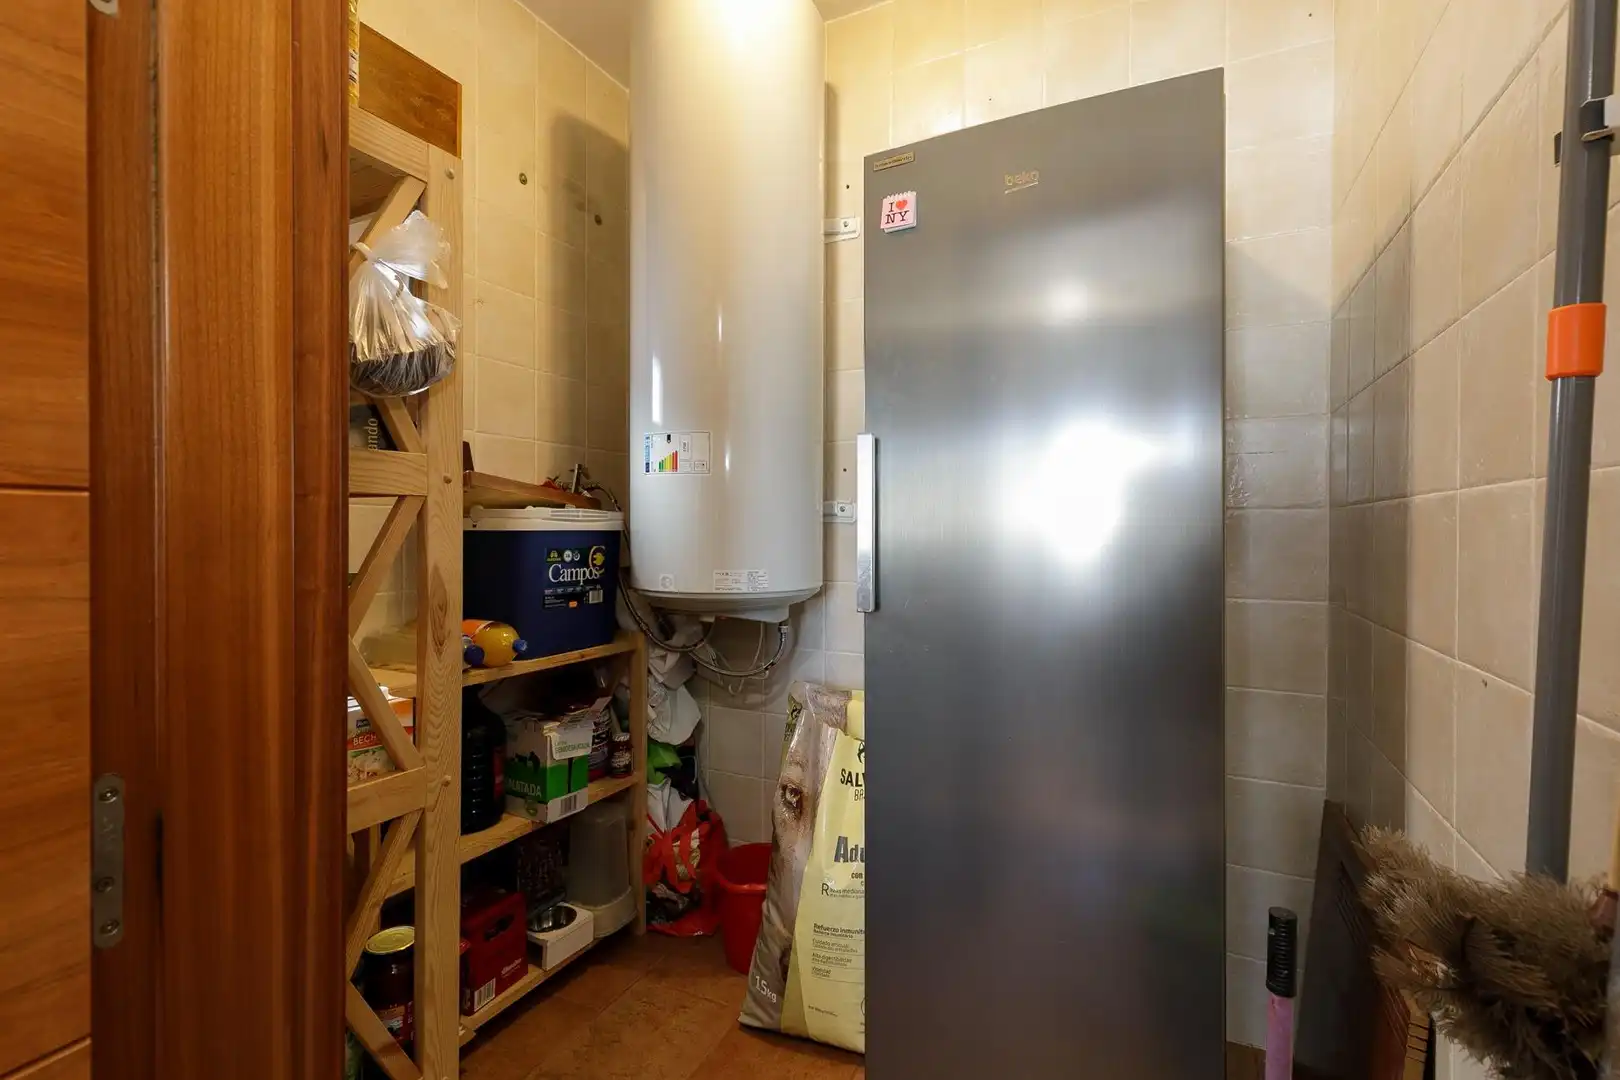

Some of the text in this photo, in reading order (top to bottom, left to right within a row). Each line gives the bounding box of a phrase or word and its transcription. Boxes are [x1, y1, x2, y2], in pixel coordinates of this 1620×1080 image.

[1005, 170, 1040, 186] beko
[884, 209, 910, 225] NY
[548, 563, 600, 586] Campos
